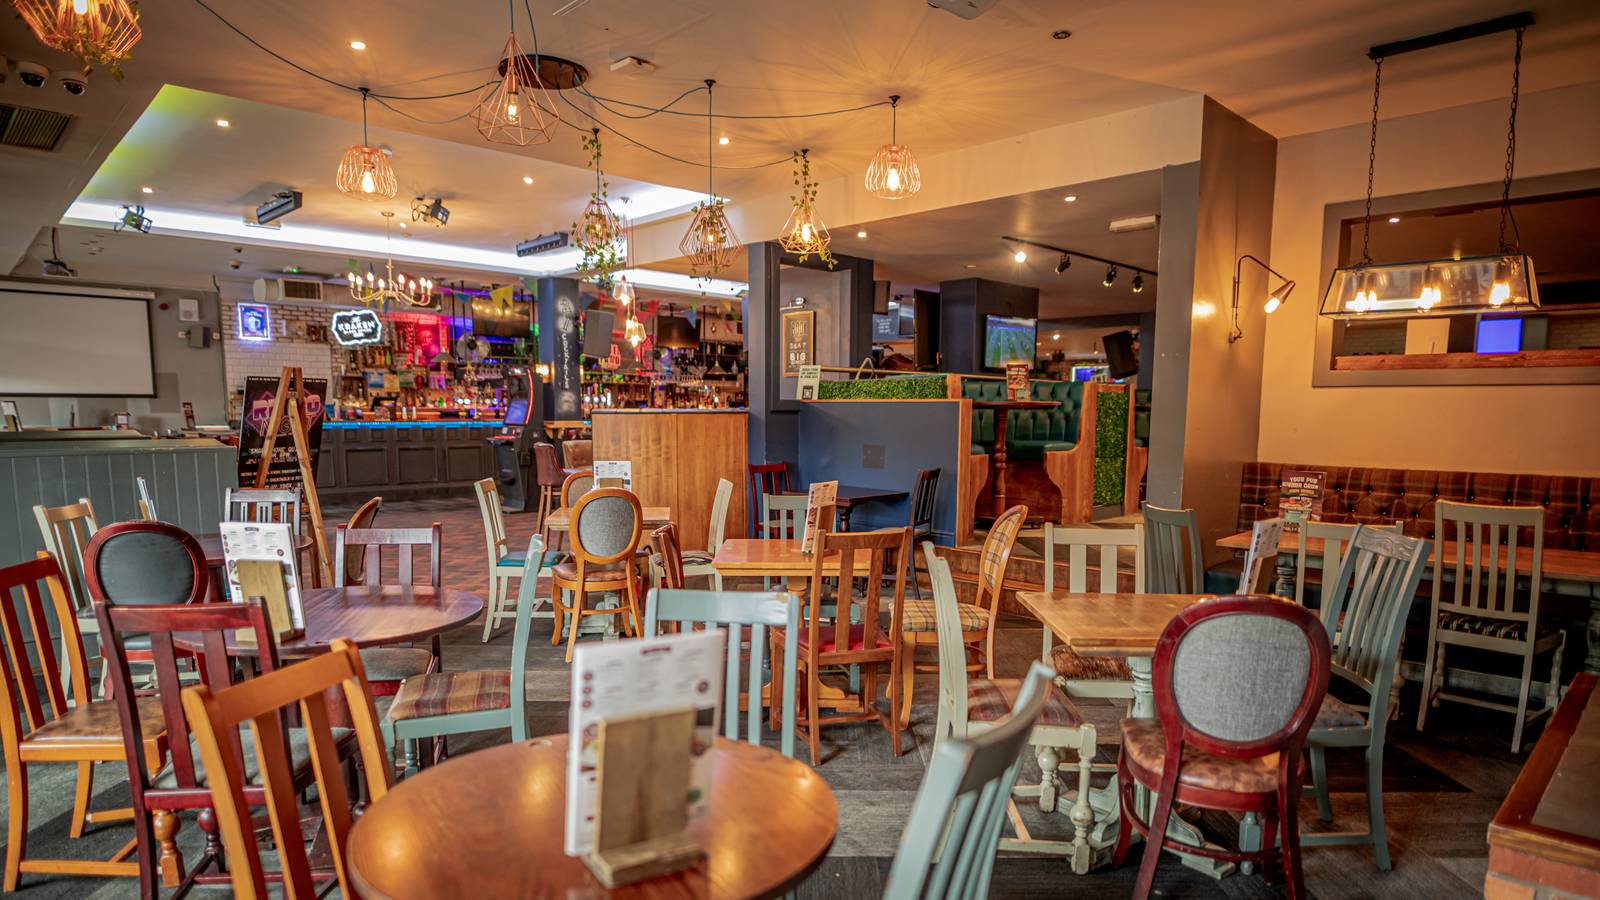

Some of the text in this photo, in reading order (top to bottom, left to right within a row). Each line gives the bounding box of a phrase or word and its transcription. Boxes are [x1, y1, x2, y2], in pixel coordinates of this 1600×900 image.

[338, 320, 376, 331] KRAKEN
[562, 333, 570, 389] COCKTAILS
[789, 352, 806, 360] BIG
